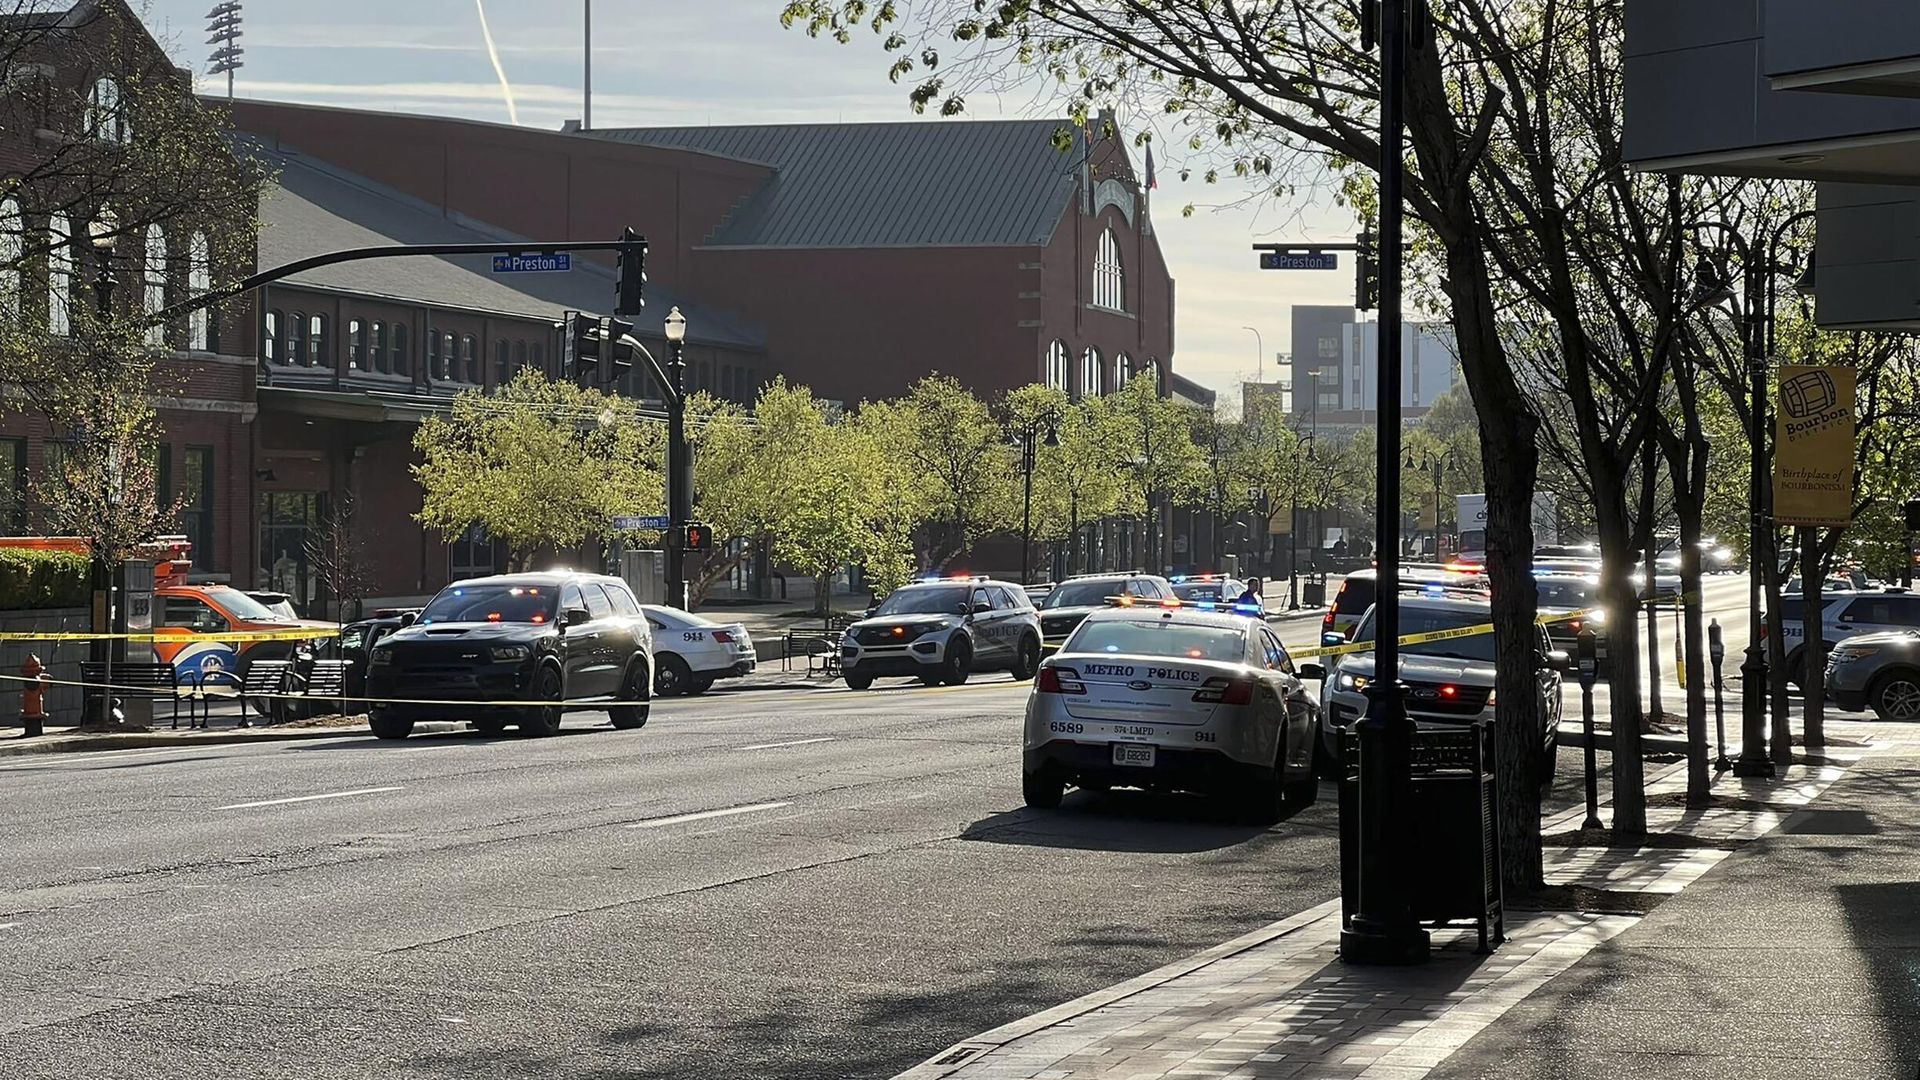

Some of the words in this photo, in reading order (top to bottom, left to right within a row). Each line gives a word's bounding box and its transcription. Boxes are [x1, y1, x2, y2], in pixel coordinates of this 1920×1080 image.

[504, 258, 511, 268] N
[512, 257, 556, 270] Preston
[1272, 256, 1279, 266] S
[1280, 255, 1323, 268] Preston
[1785, 408, 1848, 435] Bourbon
[1789, 416, 1850, 442] DISTRICT
[1782, 467, 1831, 482] Birthplace
[1832, 468, 1844, 482] of
[1781, 481, 1845, 491] BOURBONISM
[627, 518, 659, 528] Preston
[683, 632, 704, 642] 911
[1084, 664, 1134, 677] METRO
[1147, 667, 1200, 682] POLICE
[1050, 721, 1084, 734] 6589
[1195, 731, 1216, 743] 911
